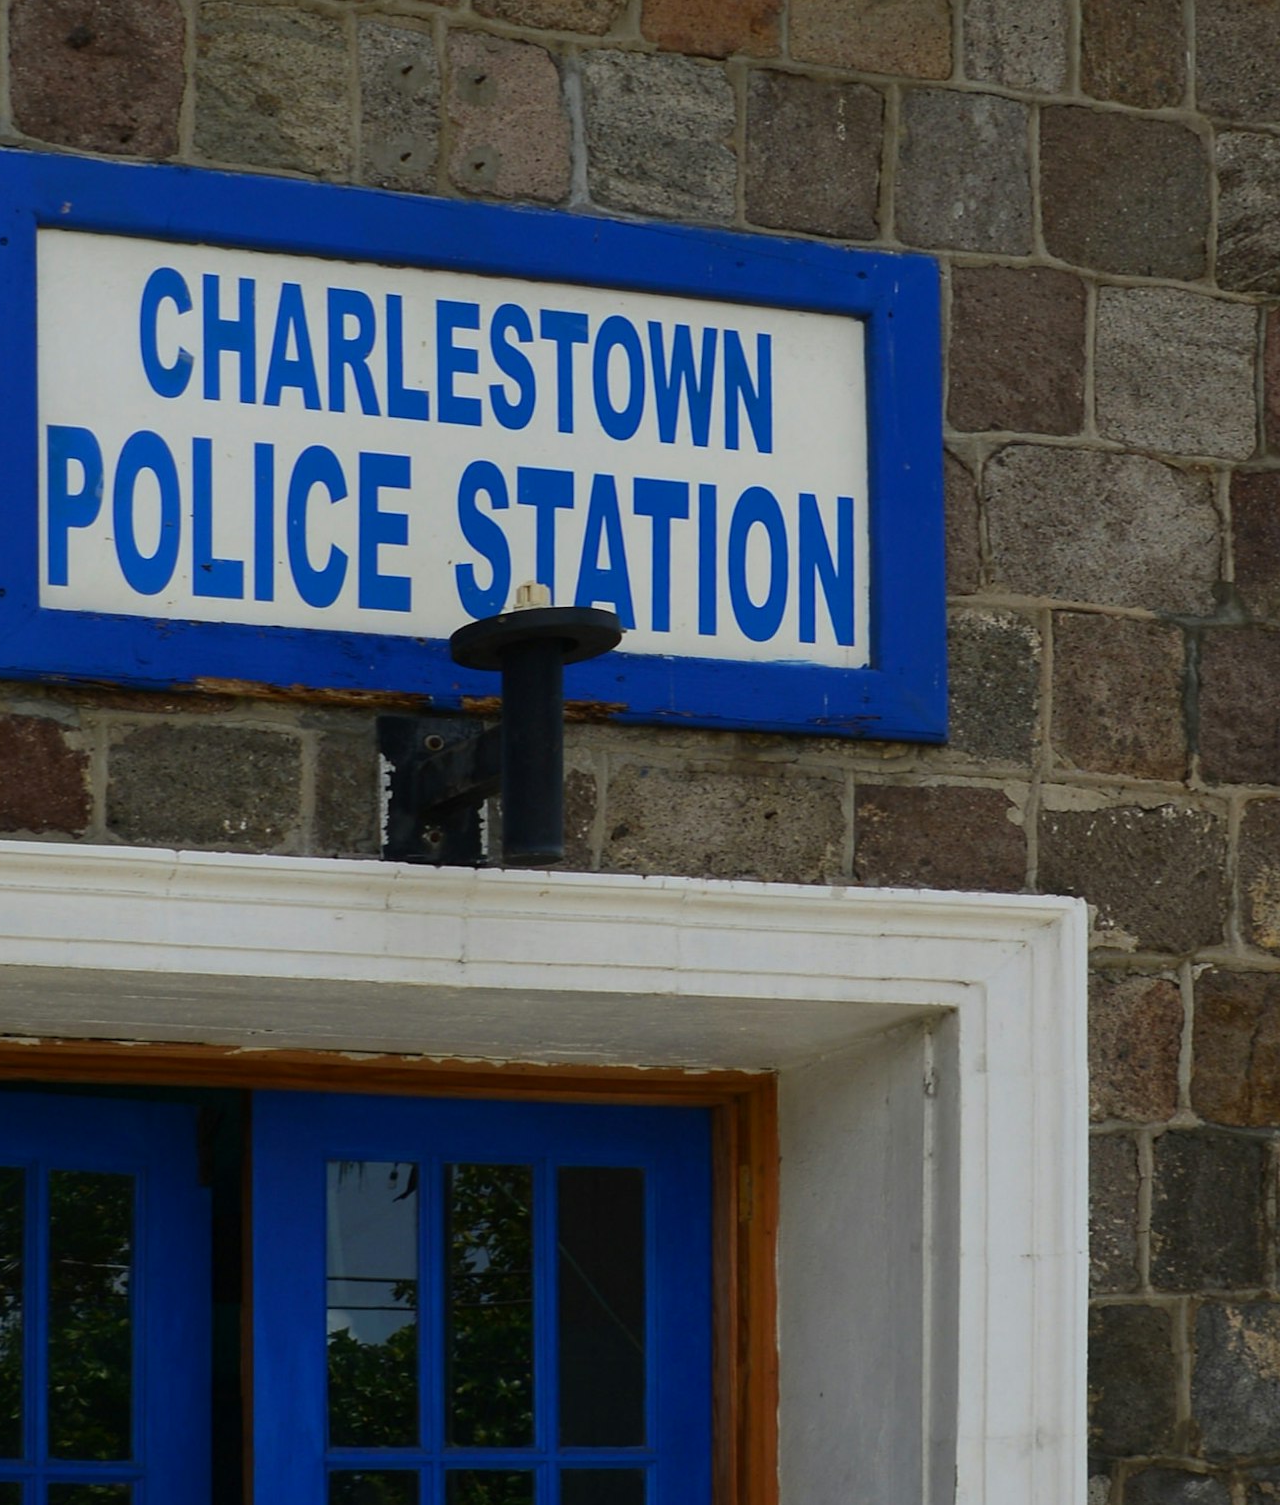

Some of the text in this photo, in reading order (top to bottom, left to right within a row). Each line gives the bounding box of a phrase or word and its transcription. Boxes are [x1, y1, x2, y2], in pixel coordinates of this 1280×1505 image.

[139, 266, 773, 454] CHARLESTOWN
[46, 423, 855, 647] POLICE STATION
